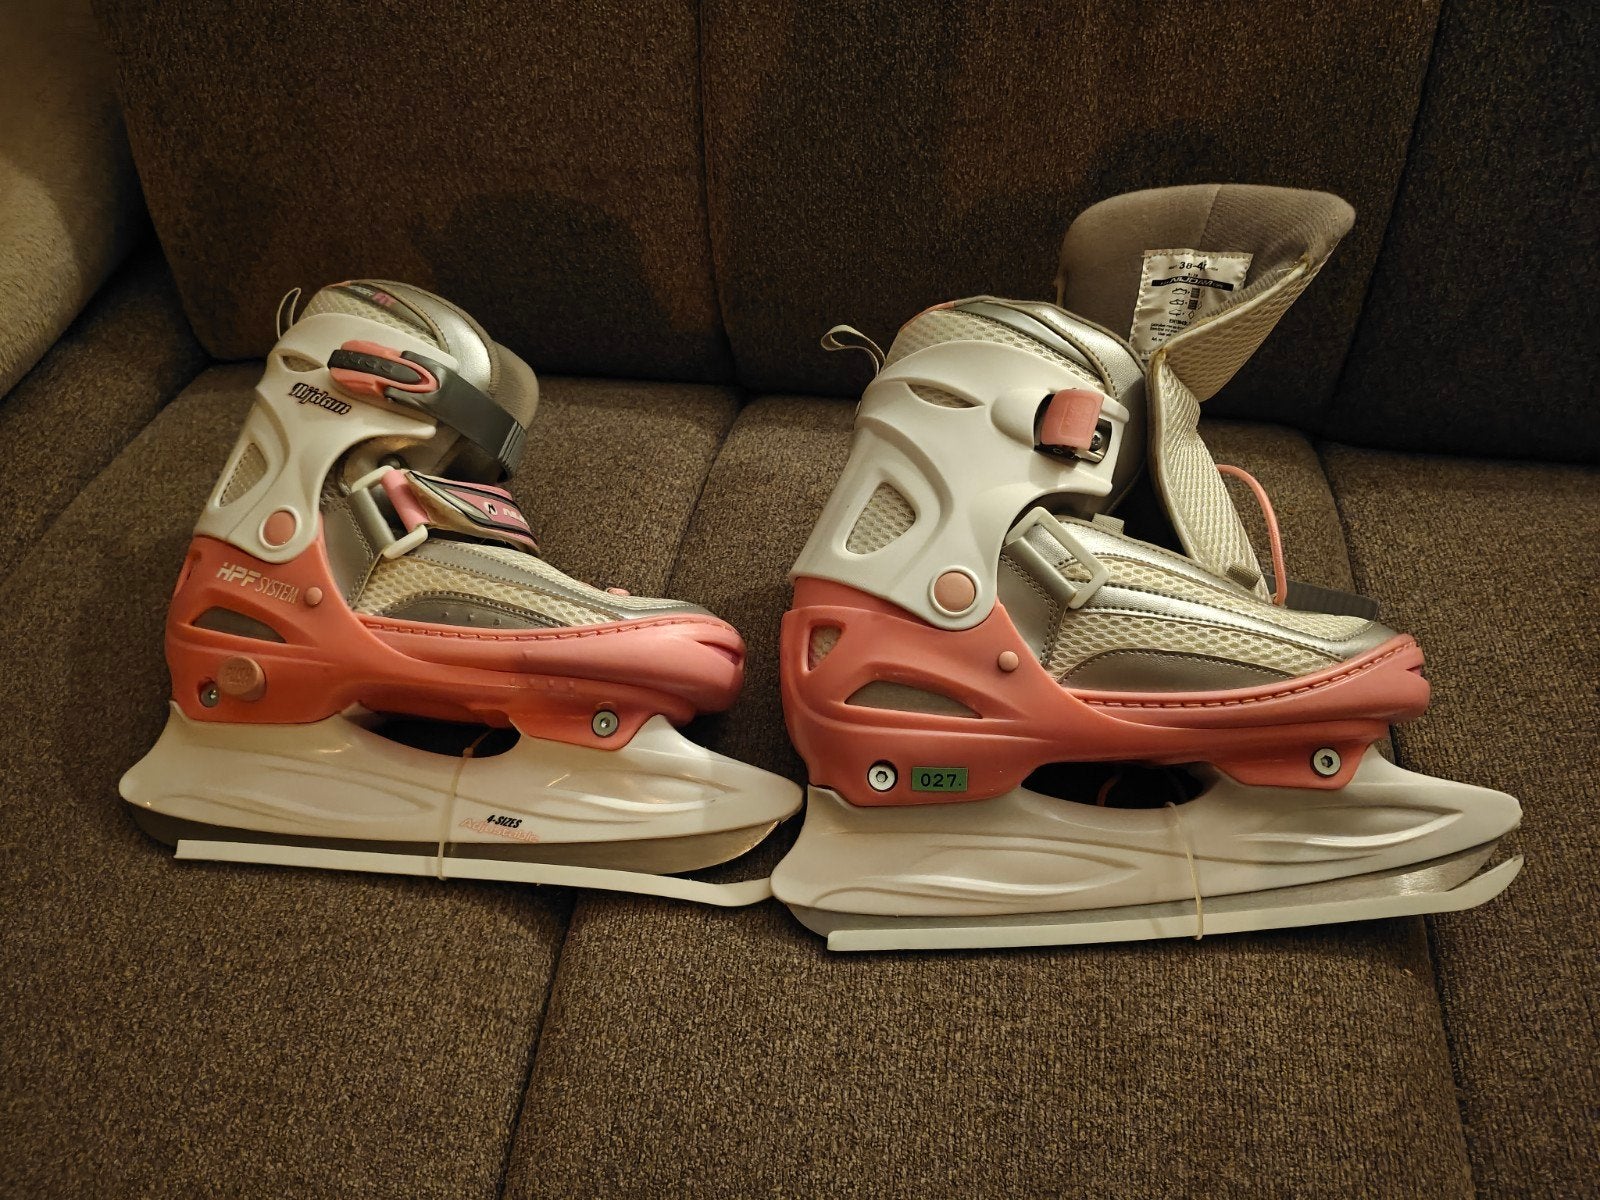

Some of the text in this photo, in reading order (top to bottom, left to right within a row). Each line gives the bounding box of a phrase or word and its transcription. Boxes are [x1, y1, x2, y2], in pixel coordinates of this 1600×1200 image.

[289, 382, 352, 415] Nijdam
[216, 562, 300, 604] HPF SYSTEM
[459, 818, 540, 843] Adjustable
[486, 814, 523, 829] 4-SIZES
